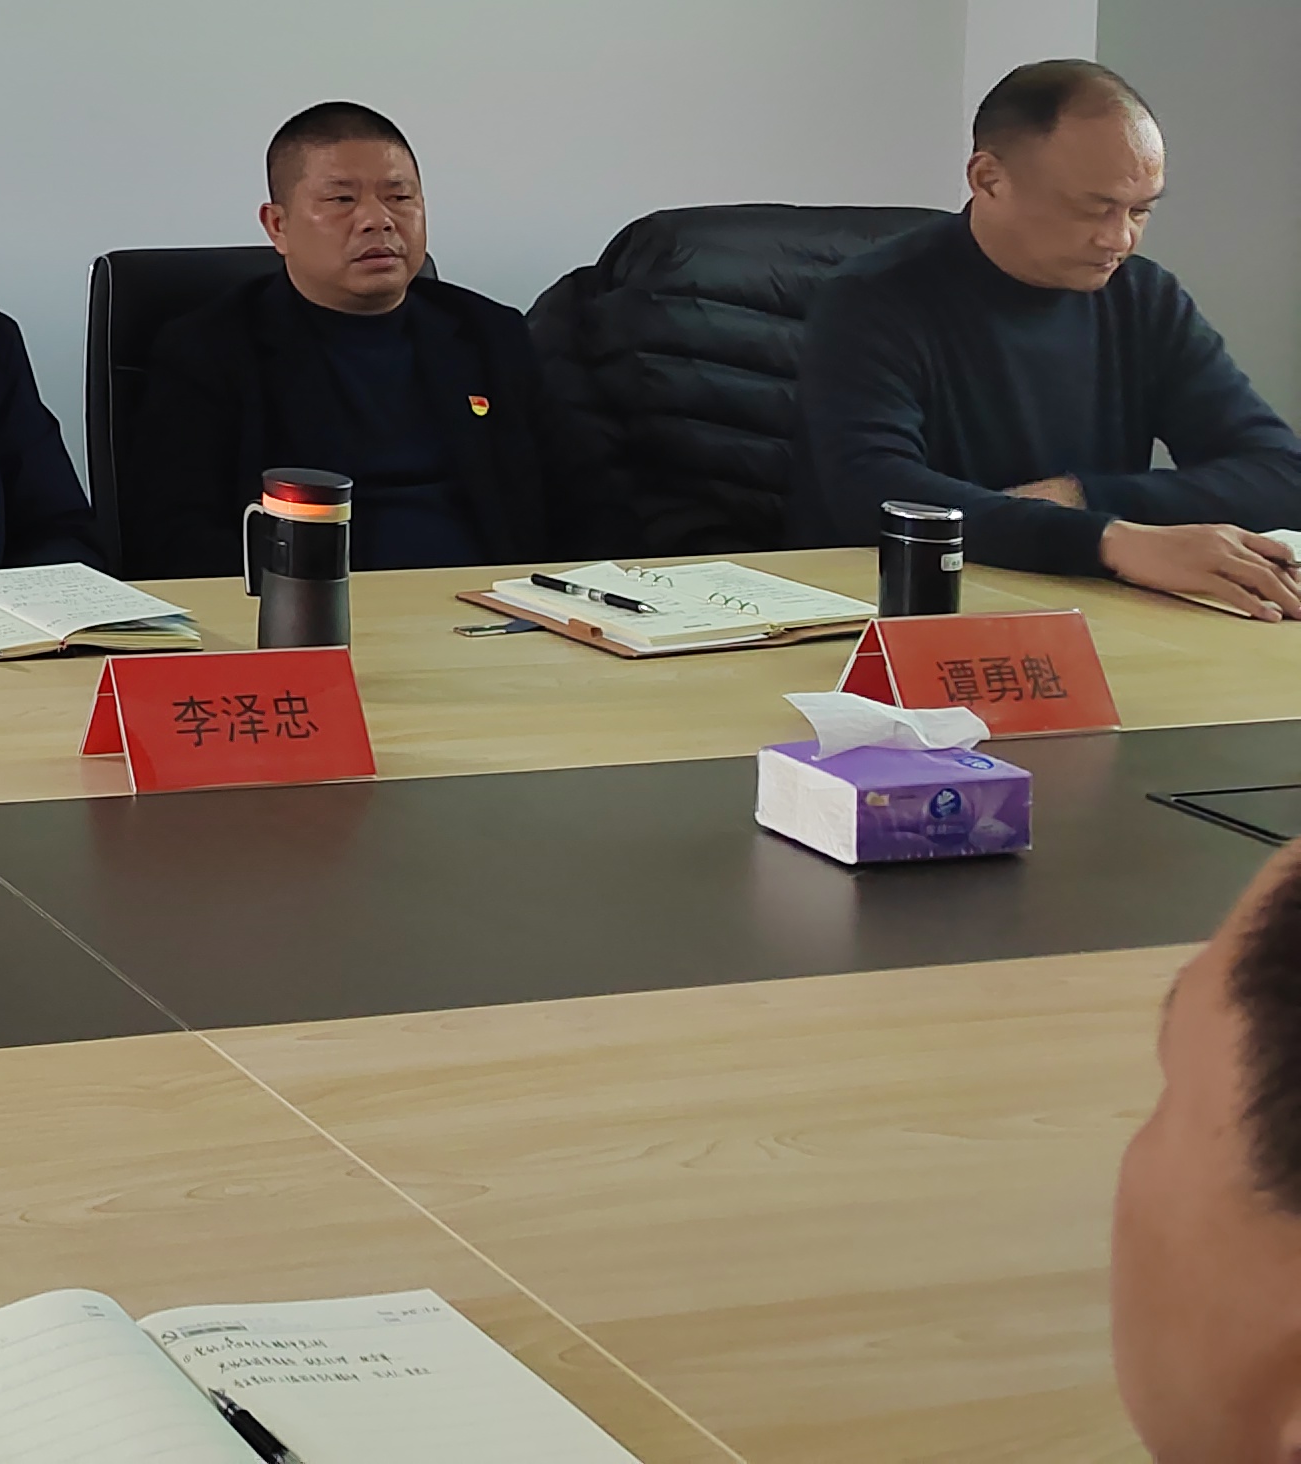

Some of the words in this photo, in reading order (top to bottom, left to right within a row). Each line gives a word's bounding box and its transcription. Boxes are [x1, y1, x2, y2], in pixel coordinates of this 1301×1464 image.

[936, 654, 1068, 705] 谭勇魁
[172, 690, 319, 747] 李泽忠
